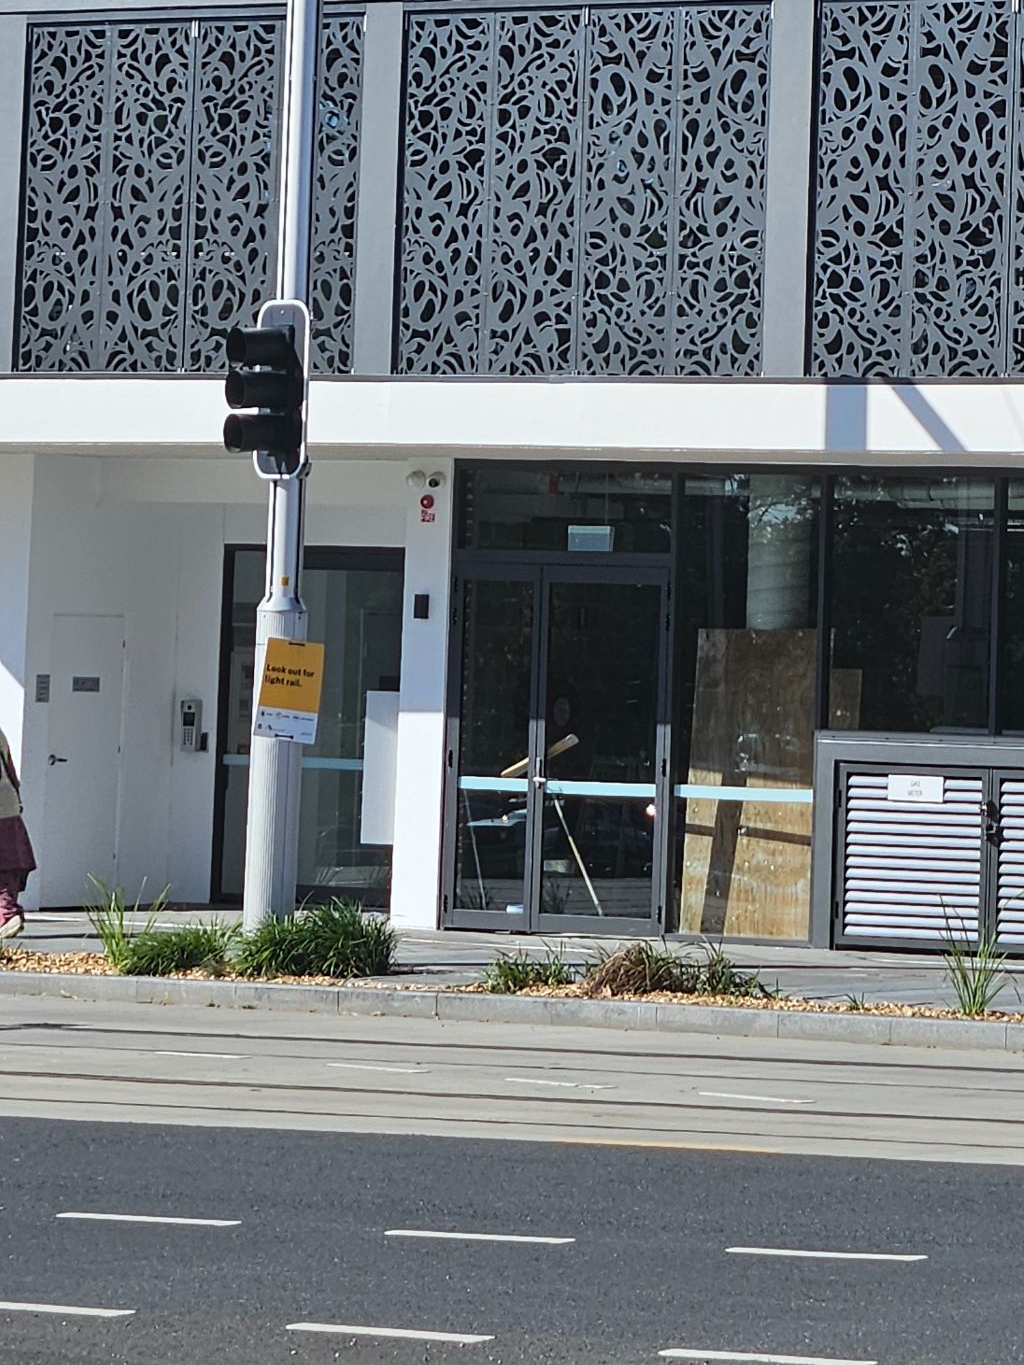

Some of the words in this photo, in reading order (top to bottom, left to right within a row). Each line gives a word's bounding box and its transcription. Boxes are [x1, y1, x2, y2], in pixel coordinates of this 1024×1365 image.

[266, 664, 286, 674] Look
[288, 667, 301, 676] out
[303, 668, 315, 678] for
[264, 675, 285, 686] light
[286, 677, 303, 687] rail.
